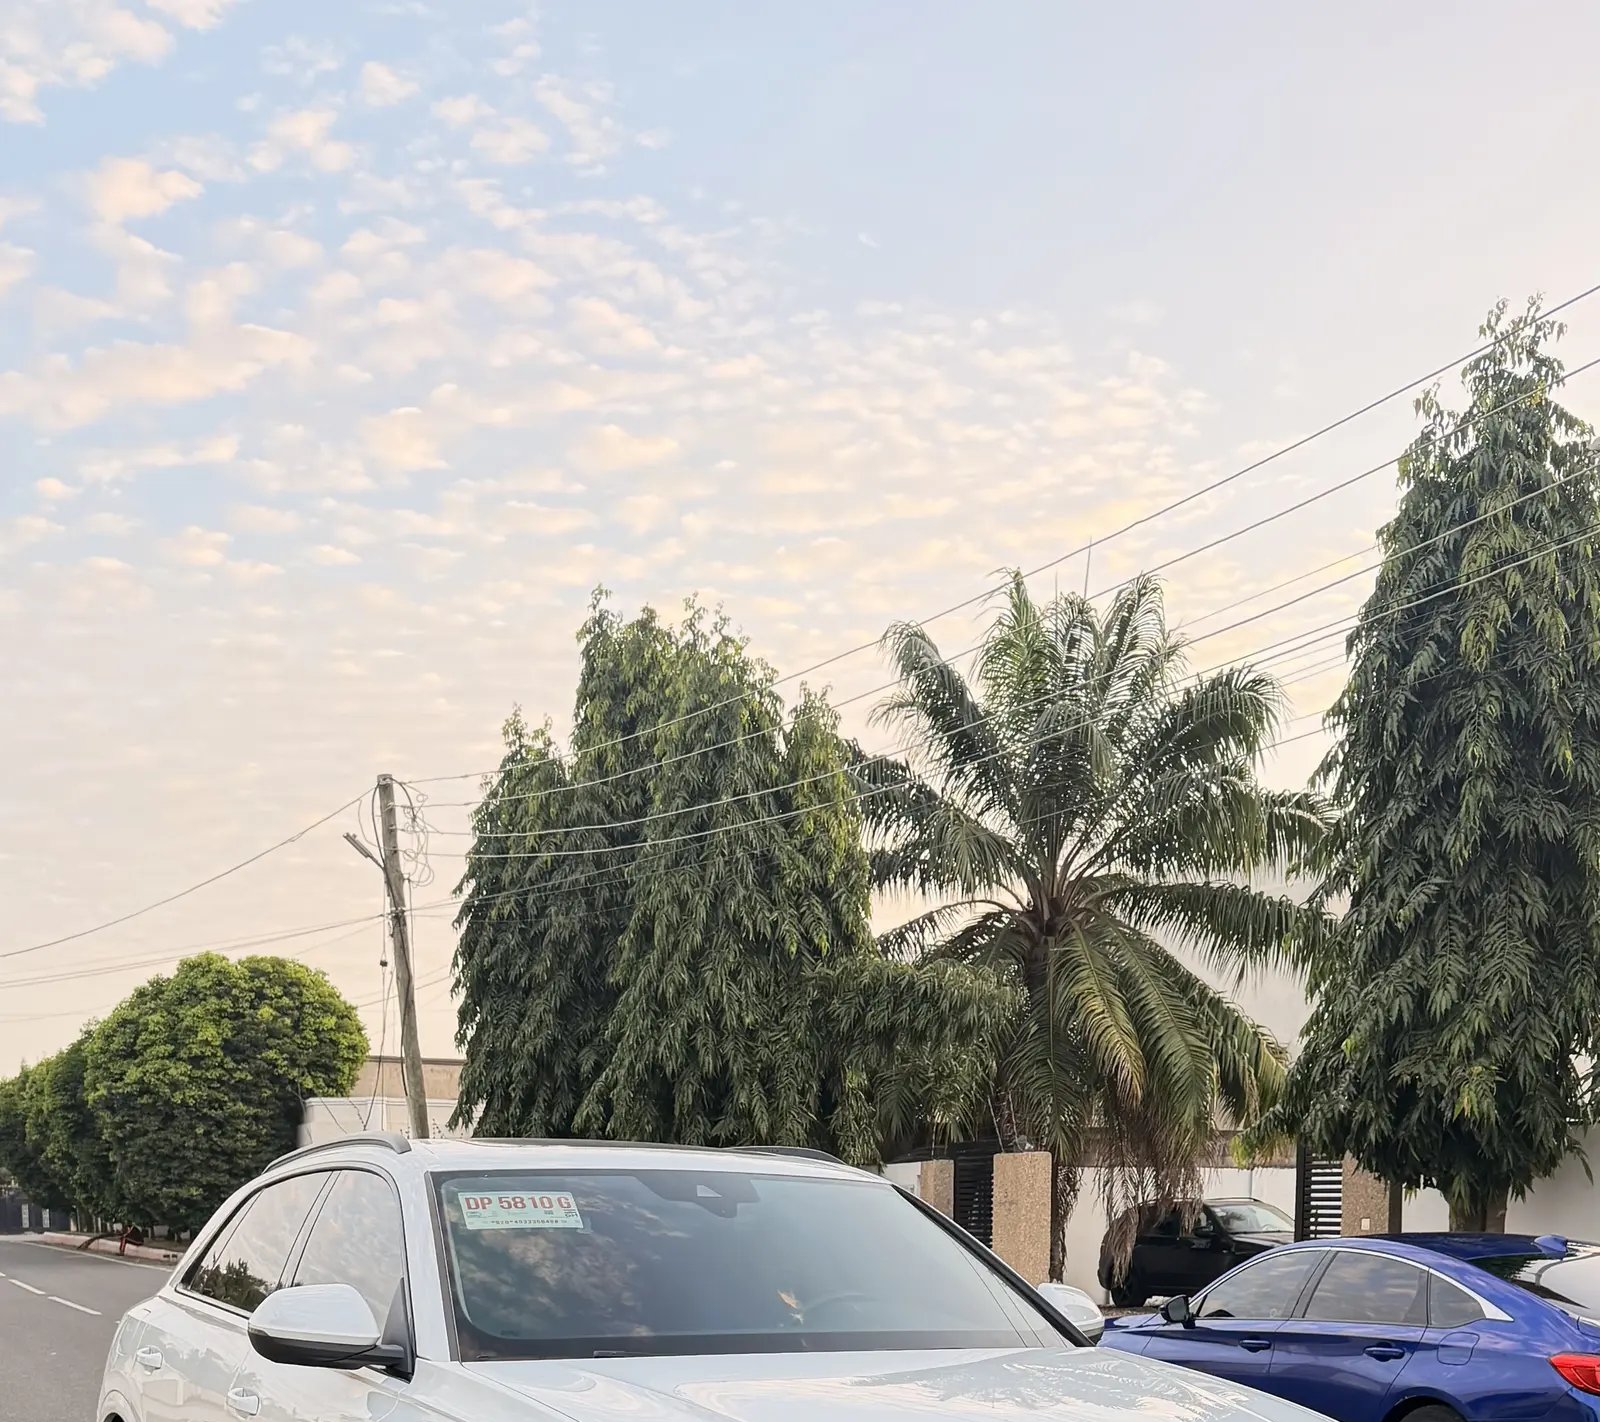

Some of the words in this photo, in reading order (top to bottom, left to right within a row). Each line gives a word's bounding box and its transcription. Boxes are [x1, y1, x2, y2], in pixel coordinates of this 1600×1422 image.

[465, 1197, 493, 1210] DP
[498, 1196, 554, 1209] 5810
[557, 1196, 572, 1209] G
